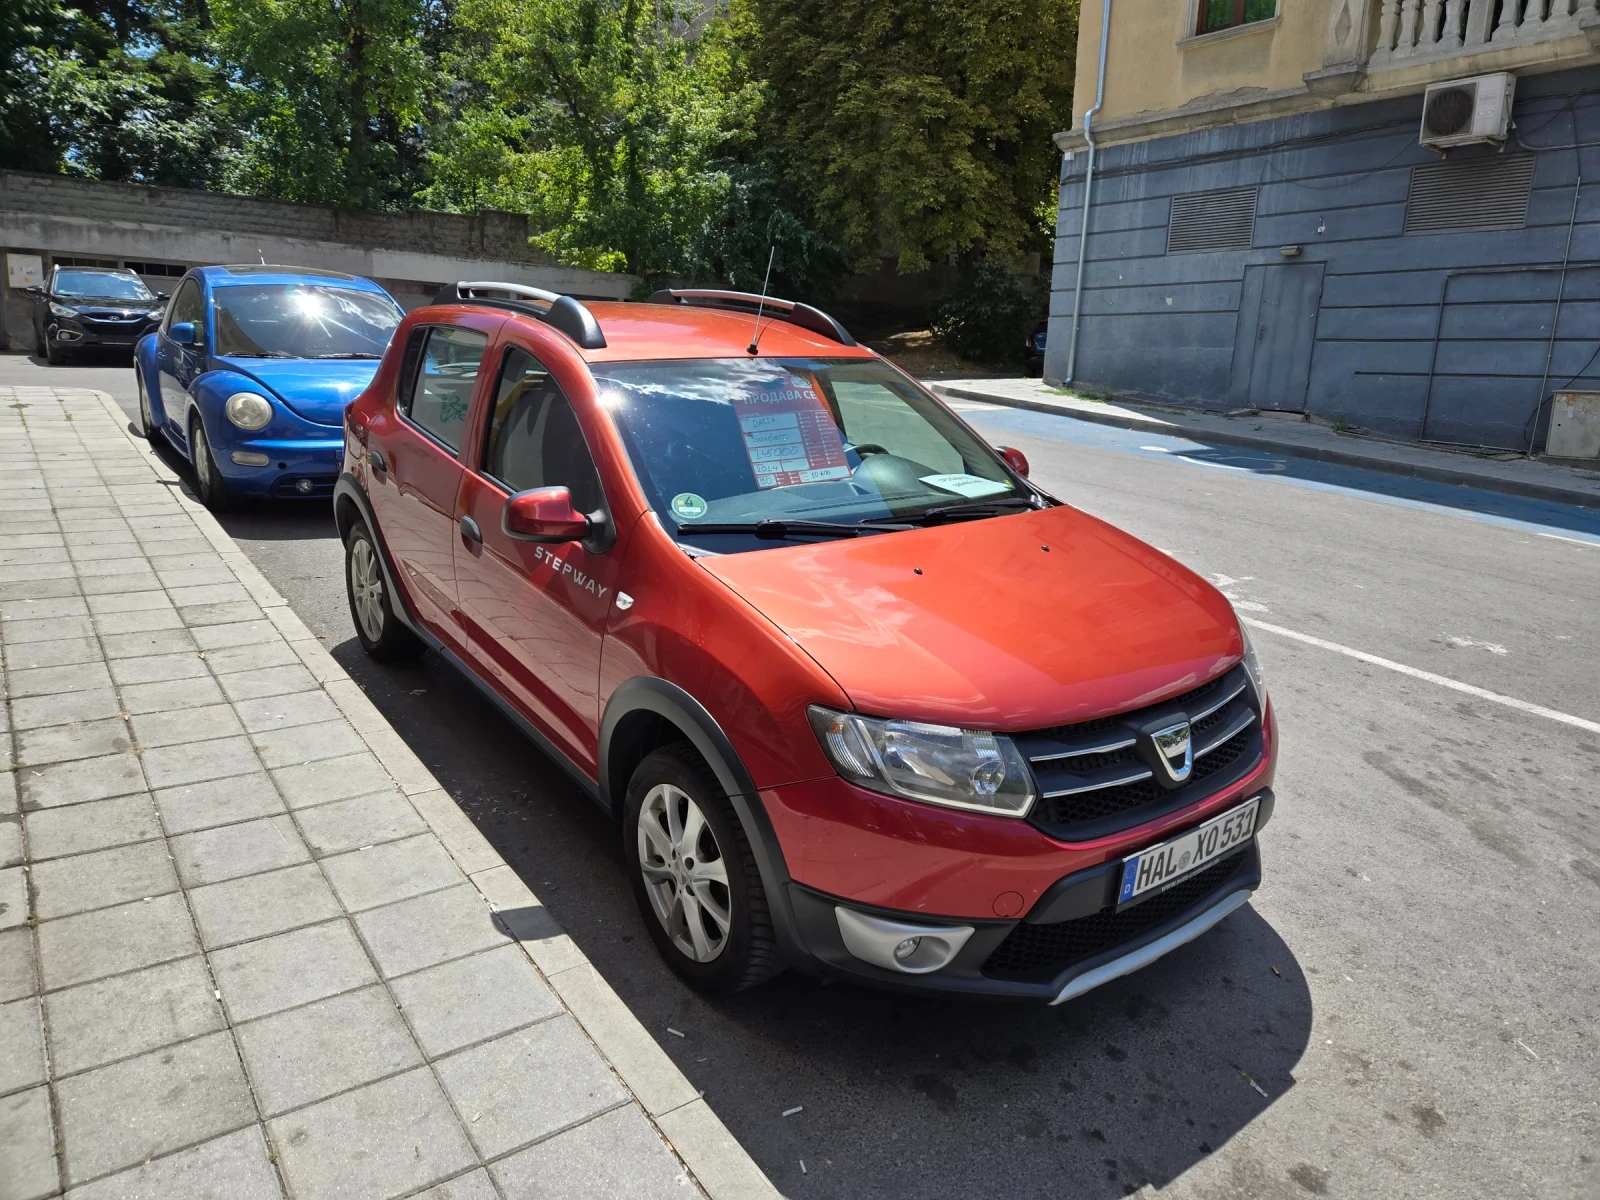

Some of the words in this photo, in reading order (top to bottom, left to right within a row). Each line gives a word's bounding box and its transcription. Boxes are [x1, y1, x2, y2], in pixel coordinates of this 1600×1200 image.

[744, 390, 801, 404] ПРОДАВА
[803, 390, 817, 400] СЕ
[752, 416, 776, 428] DACIA
[756, 445, 798, 460] 145000
[756, 465, 778, 473] 2014
[684, 496, 693, 507] 4
[534, 545, 608, 598] STEPWAY
[1136, 847, 1177, 891] HAL
[1220, 807, 1255, 849] 531
[1124, 884, 1131, 894] D
